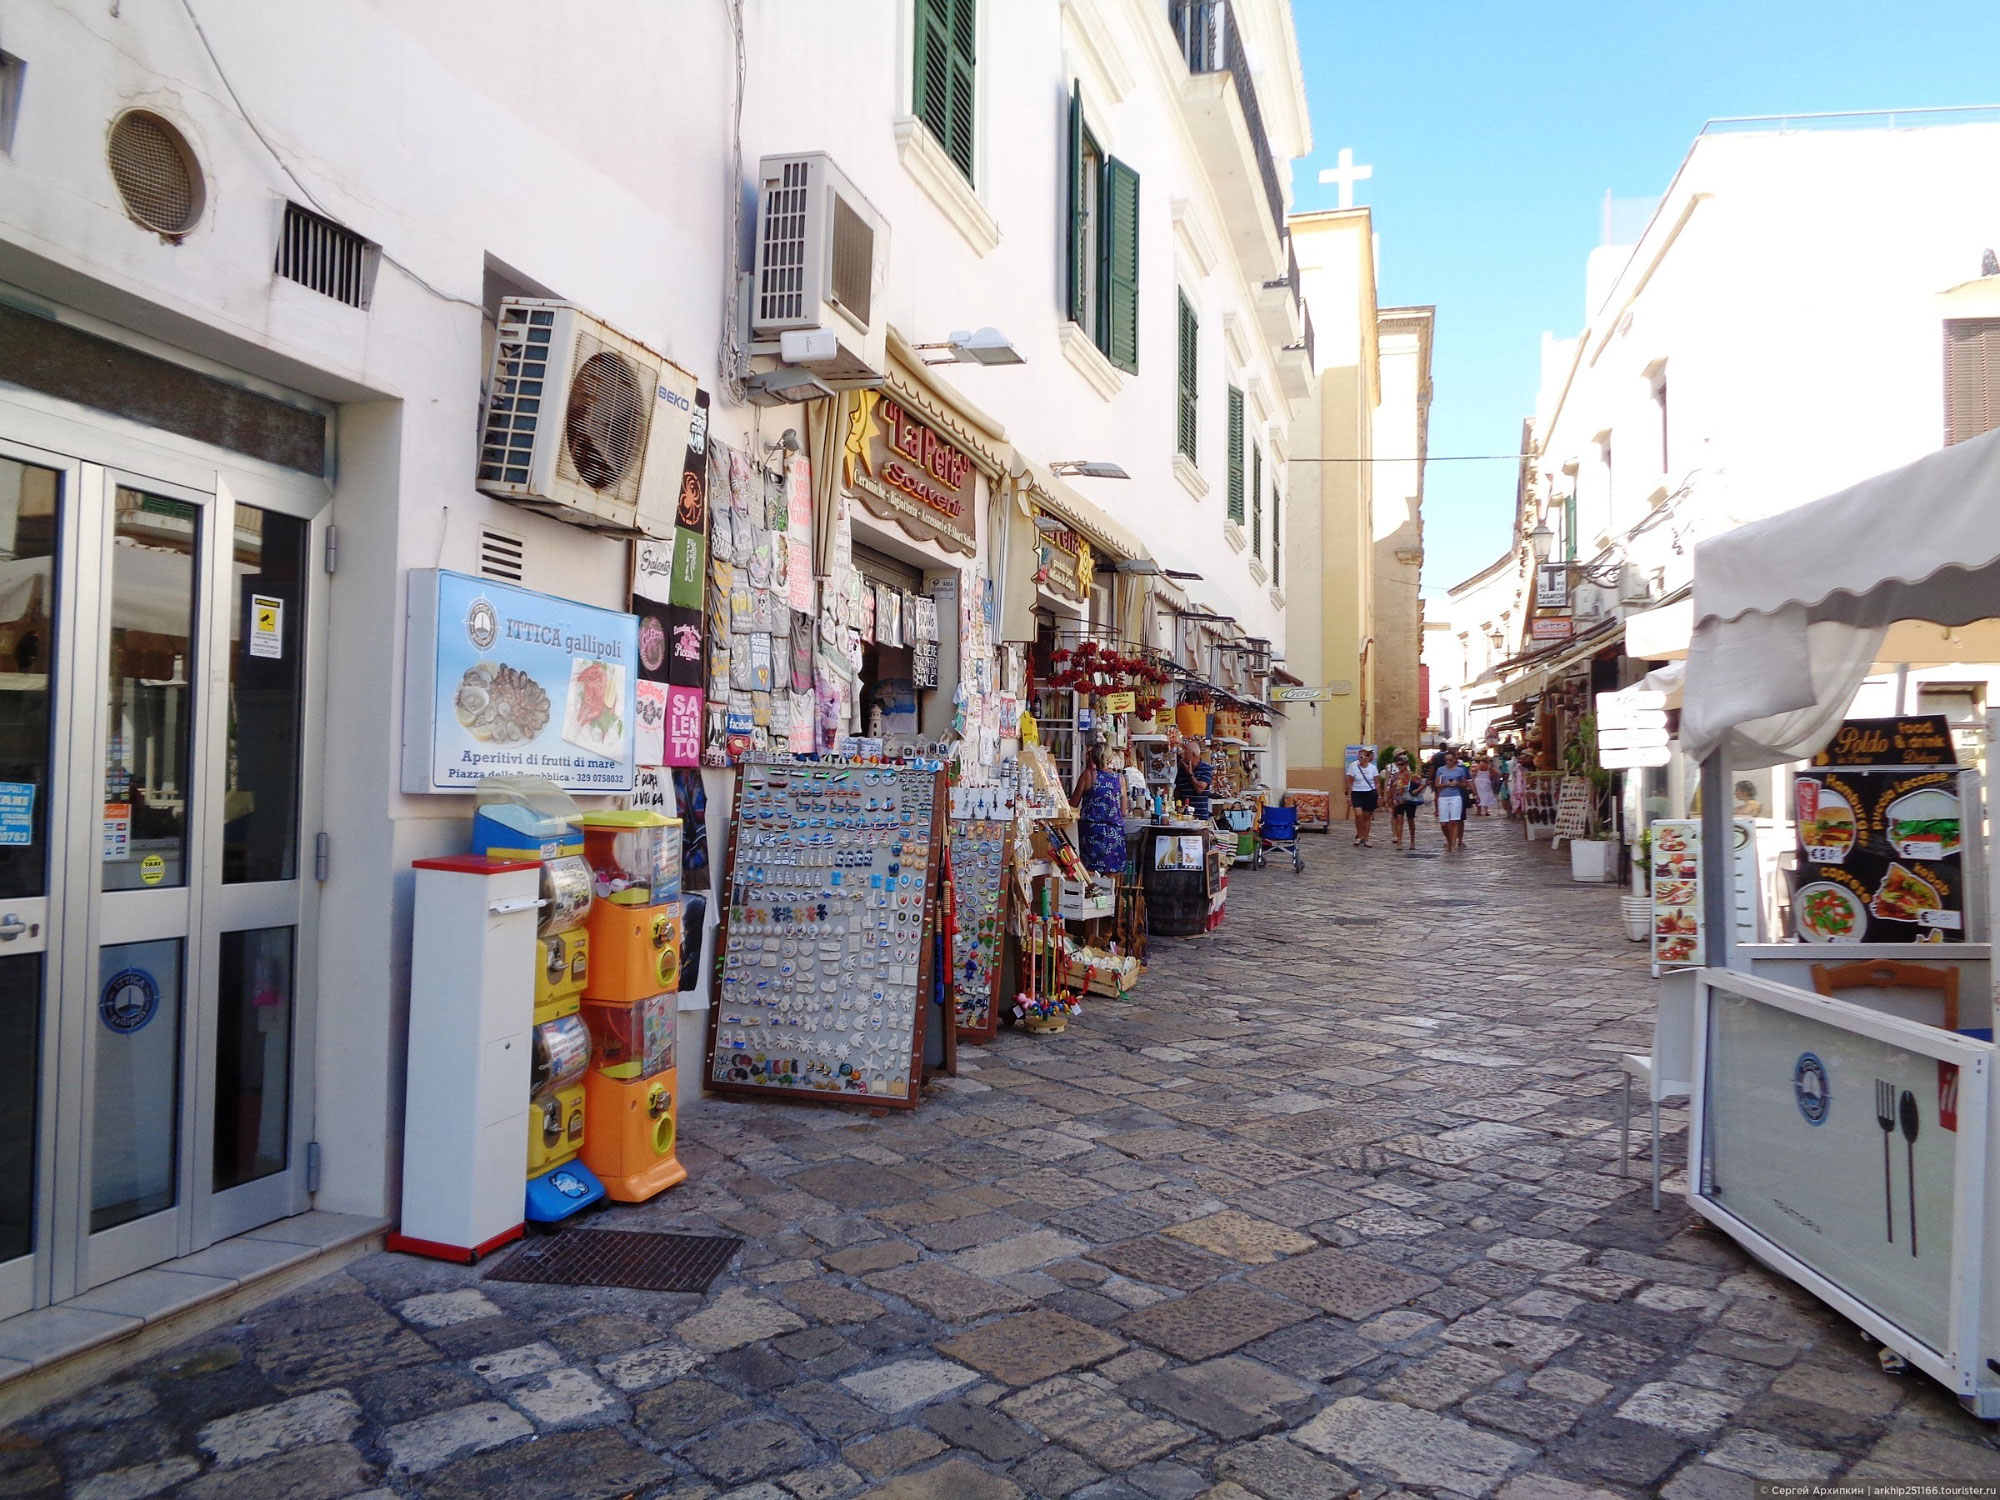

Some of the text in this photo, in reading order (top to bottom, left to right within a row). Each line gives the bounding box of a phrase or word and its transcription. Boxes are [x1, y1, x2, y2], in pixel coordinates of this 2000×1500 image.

[658, 385, 690, 412] BEKO
[640, 549, 671, 577] Salento
[506, 618, 562, 648] ITTICA
[565, 634, 622, 660] gallipoli
[672, 694, 699, 716] SA
[671, 715, 699, 738] LEN
[1835, 727, 1889, 753] Poldo
[461, 750, 615, 769] Aperitivi di frutti di mare
[448, 769, 484, 779] Piazza
[576, 774, 591, 782] 329
[592, 775, 623, 783] 0758032
[1820, 866, 1872, 904] caprese
